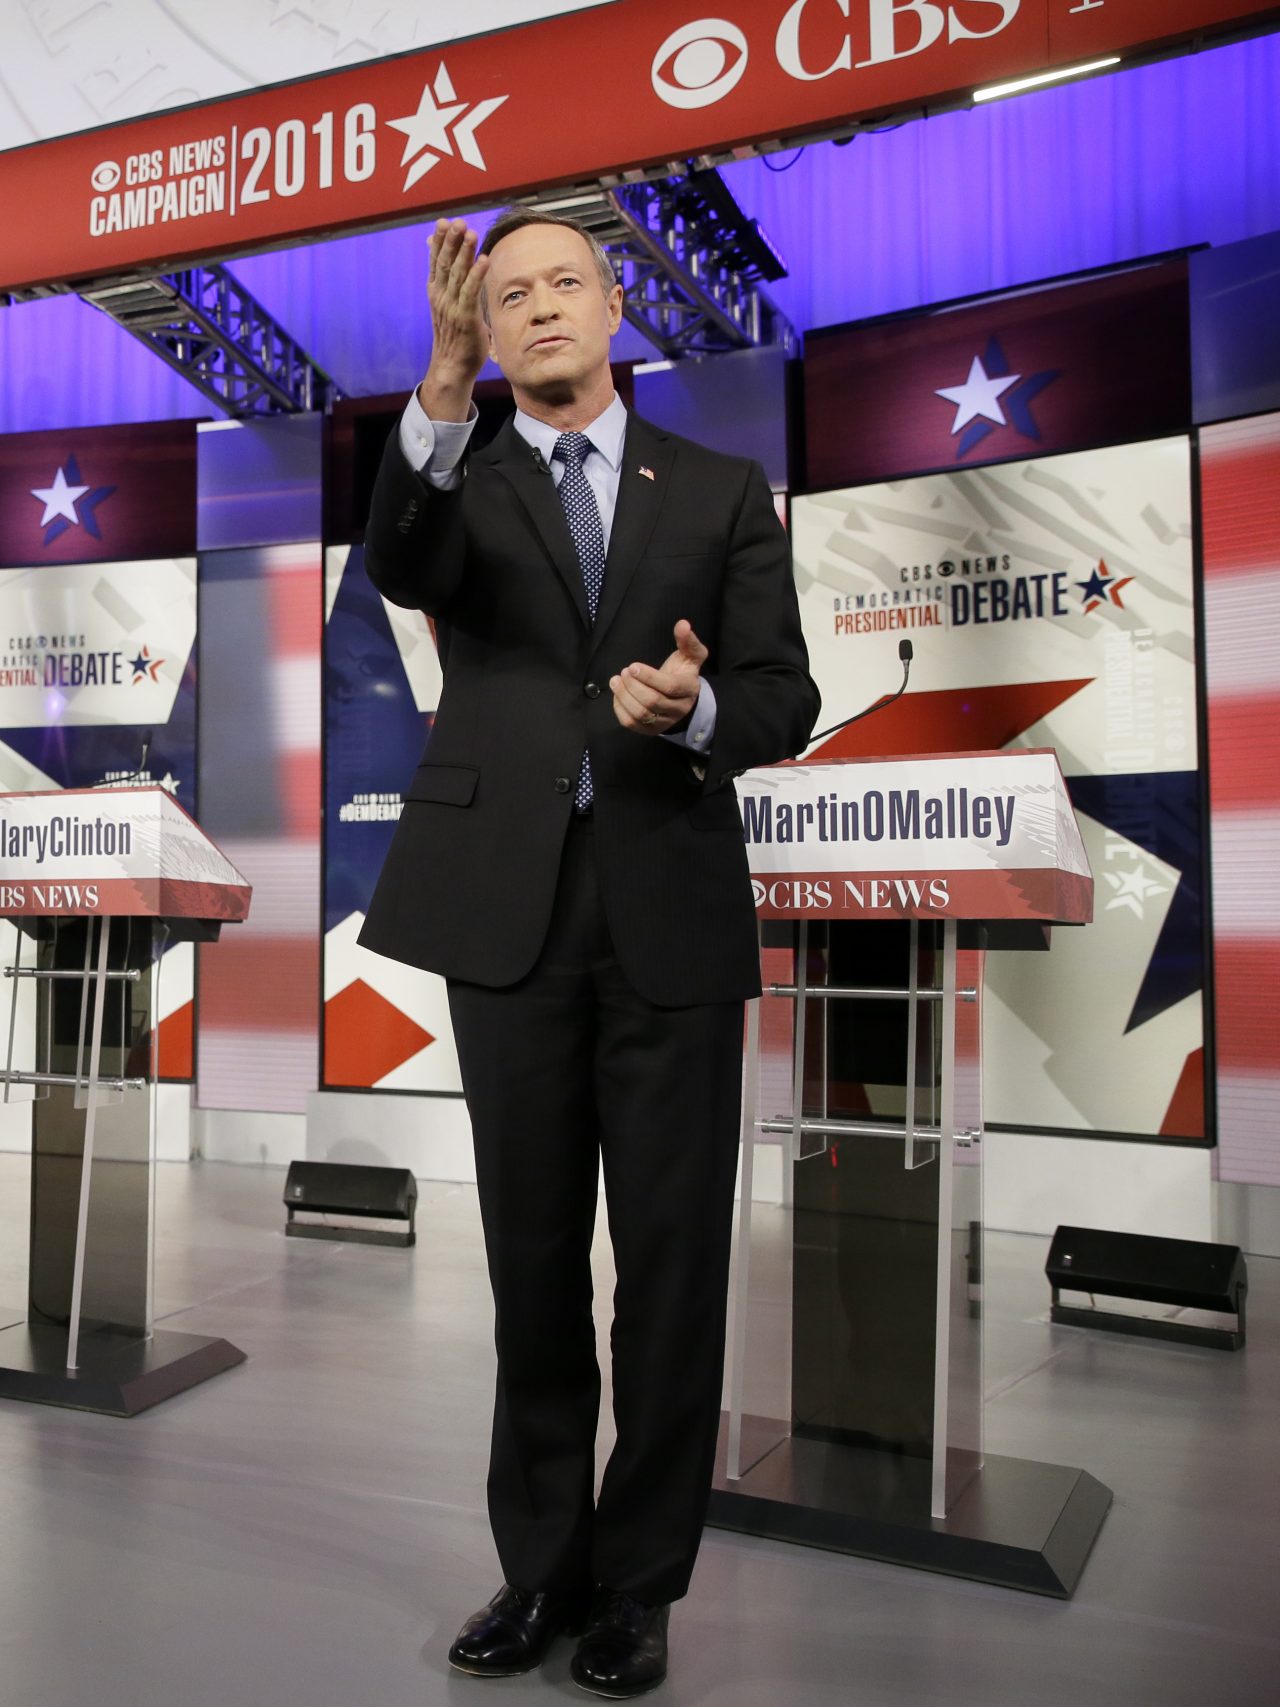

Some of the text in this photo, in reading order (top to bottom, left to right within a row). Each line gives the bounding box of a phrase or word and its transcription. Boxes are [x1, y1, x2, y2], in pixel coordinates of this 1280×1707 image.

[125, 135, 226, 186] CBS NEWS
[240, 103, 376, 205] 2016
[90, 171, 225, 237] CAMPAIGN
[900, 554, 1011, 584] CBS NEWS
[833, 585, 943, 612] DEMOCRATIC
[950, 571, 1069, 627] DEBATE
[834, 603, 943, 636] PRESIDENTIAL
[44, 652, 122, 687] DEBATE
[742, 787, 1016, 847] MartinOMalley
[33, 884, 99, 908] NEWS
[769, 878, 950, 910] CBS NEWS
